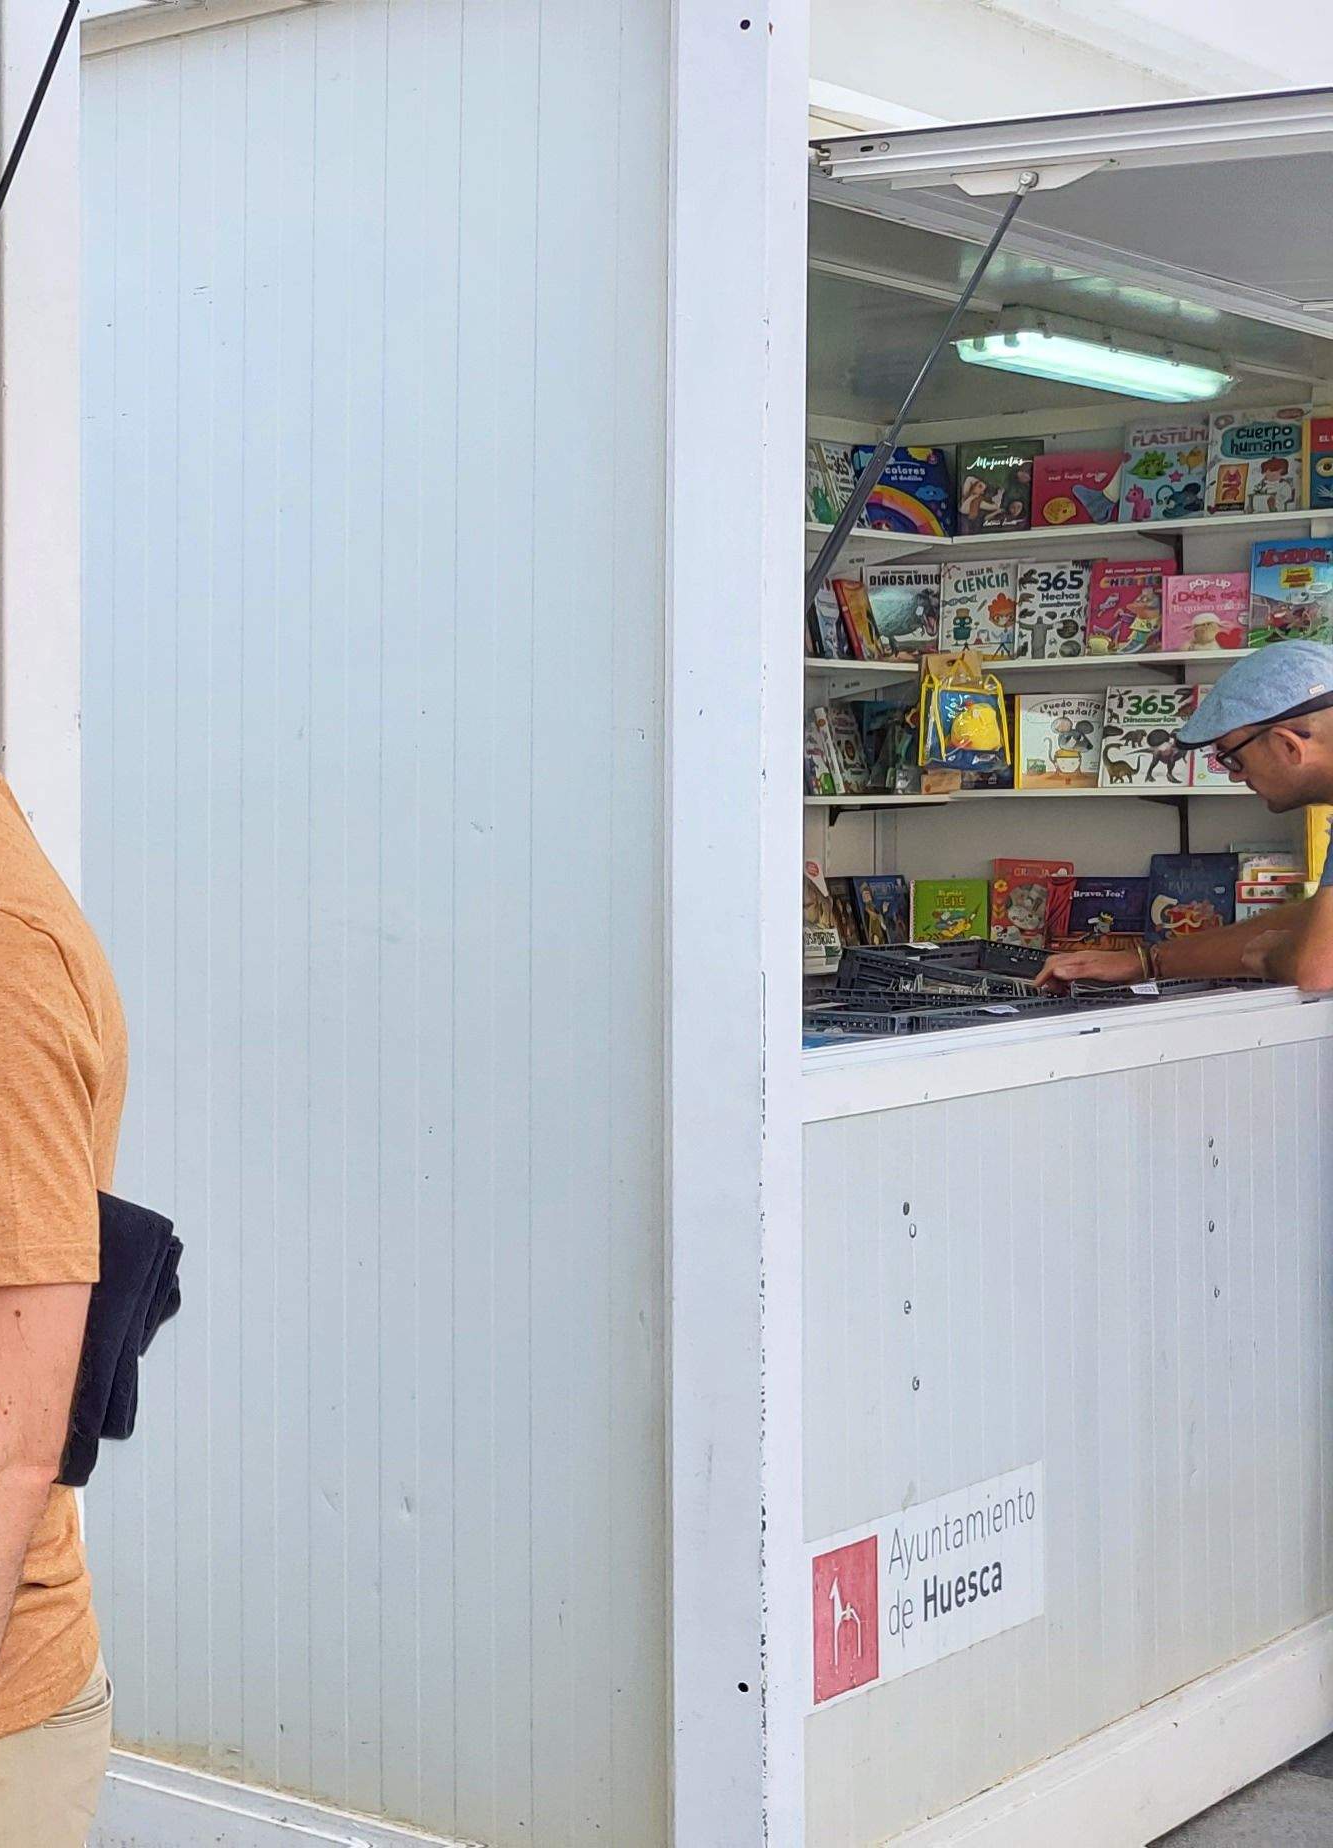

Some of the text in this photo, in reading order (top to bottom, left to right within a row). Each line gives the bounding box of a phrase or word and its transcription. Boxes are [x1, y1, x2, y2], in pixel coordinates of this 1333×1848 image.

[1230, 438, 1295, 456] humano
[954, 573, 1009, 593] CIENCIA
[1037, 571, 1083, 592] 365
[1041, 591, 1080, 601] Hechos
[1126, 695, 1175, 716] 365
[889, 1486, 1035, 1580] Ayuntamiento
[889, 1561, 1003, 1638] de Huesca
